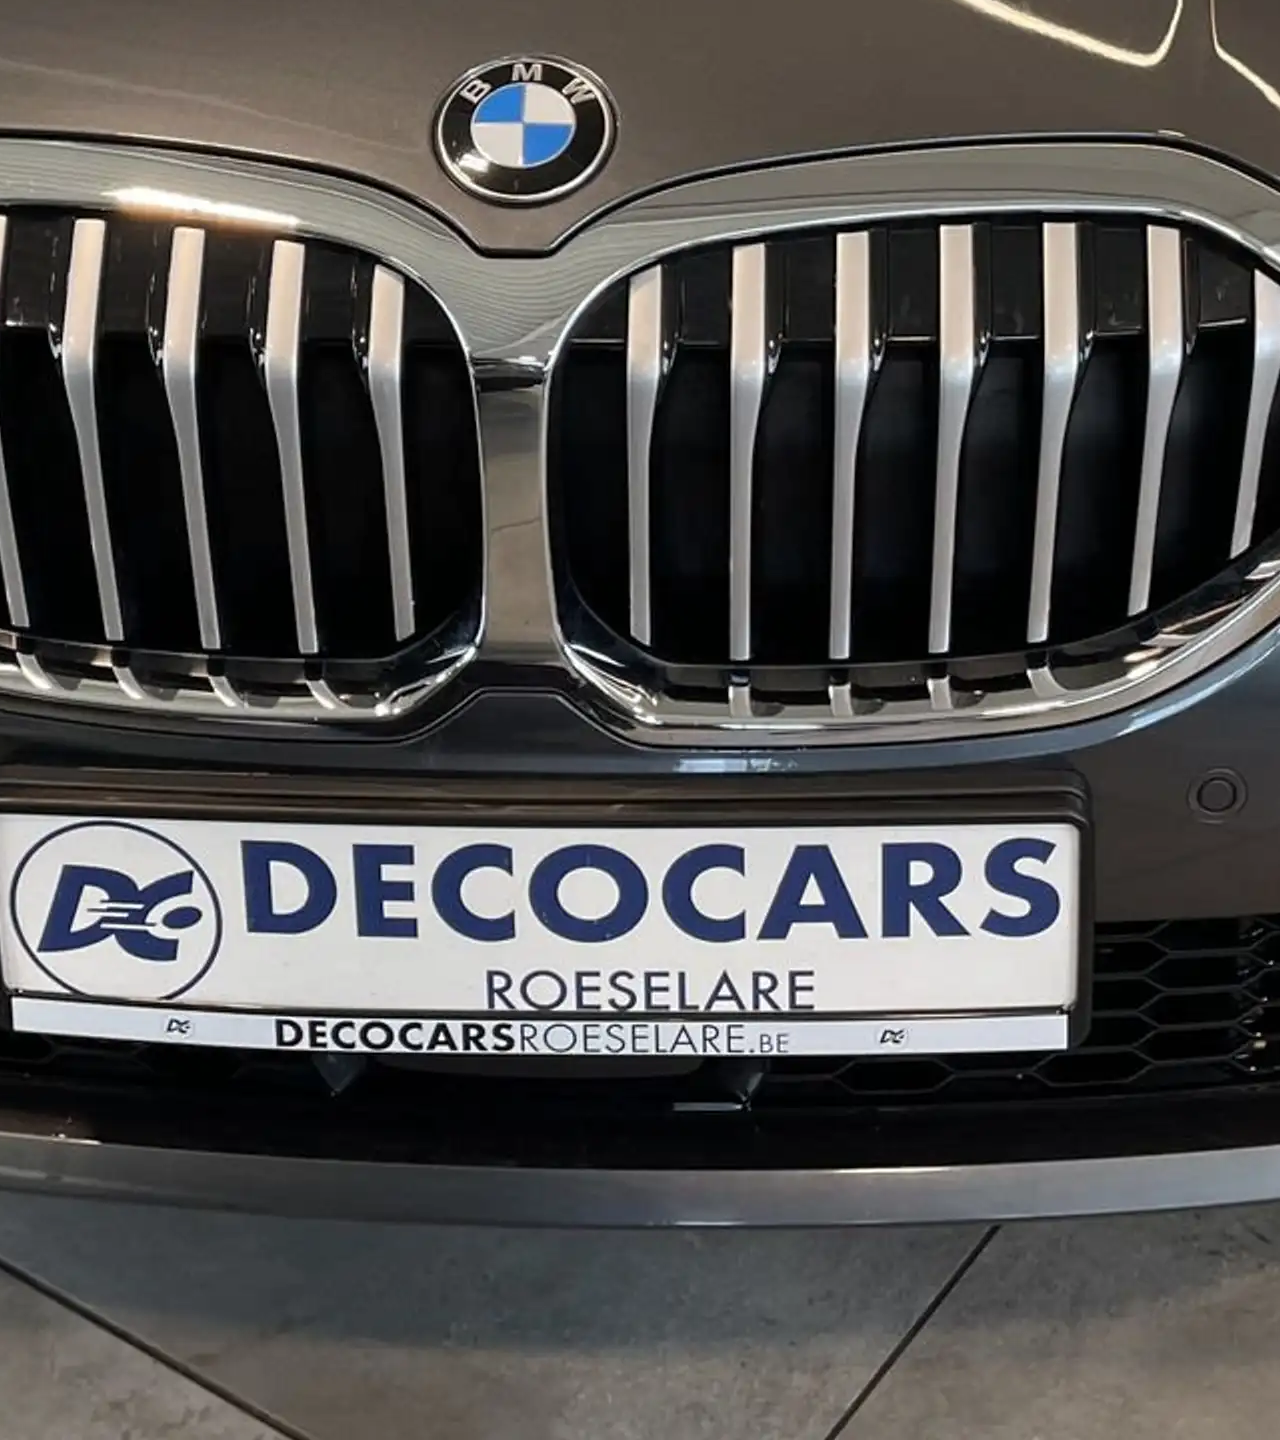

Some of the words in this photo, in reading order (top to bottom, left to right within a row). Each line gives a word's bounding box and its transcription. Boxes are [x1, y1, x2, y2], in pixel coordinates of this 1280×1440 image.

[459, 63, 596, 105] BMW
[240, 837, 1061, 943] DECOCARS
[486, 969, 815, 1012] ROESELARE
